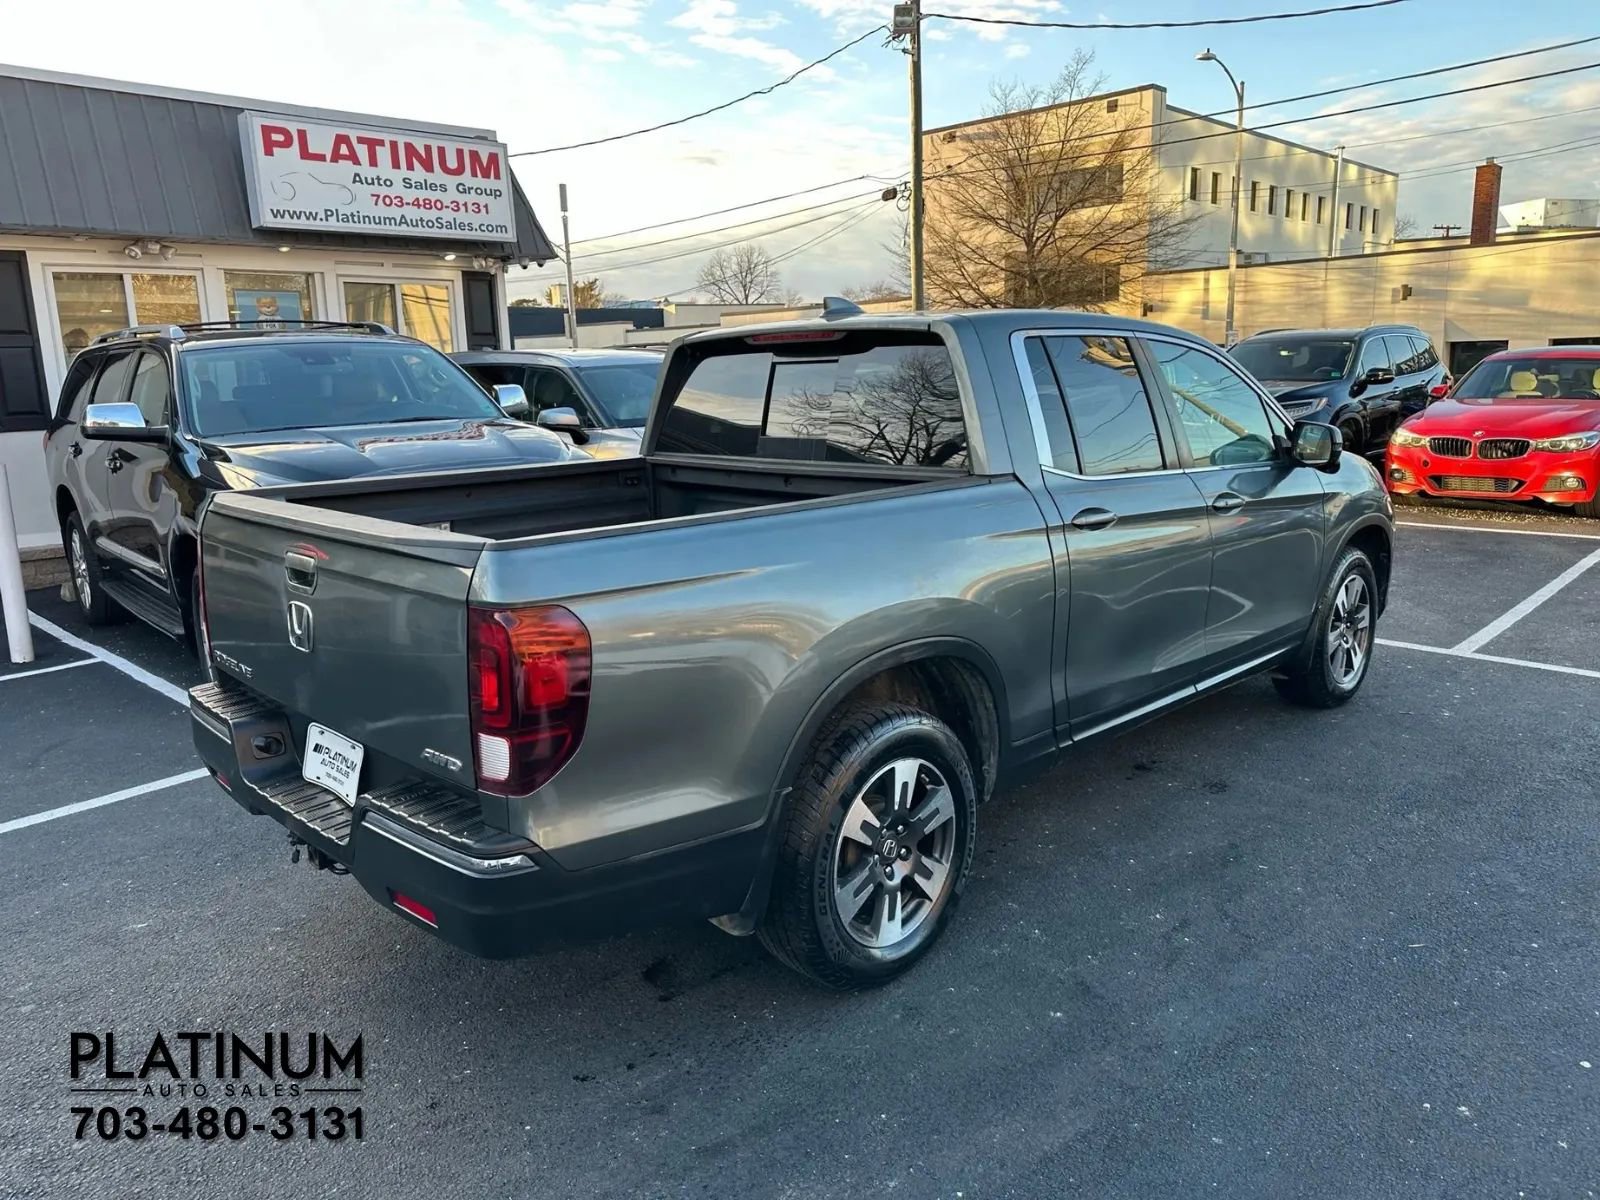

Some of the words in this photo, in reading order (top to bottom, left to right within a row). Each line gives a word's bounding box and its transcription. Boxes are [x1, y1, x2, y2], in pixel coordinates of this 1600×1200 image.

[261, 124, 501, 180] PLATINUM
[352, 172, 394, 189] Auto
[402, 176, 448, 193] Sales
[455, 182, 503, 199] Group
[370, 193, 490, 215] 703-480-3131
[270, 207, 508, 235] www.PlatinumAutoSales.com
[320, 758, 336, 770] AUTO
[335, 765, 351, 779] SALES
[323, 747, 357, 773] PLATINUM
[420, 748, 462, 772] AWD
